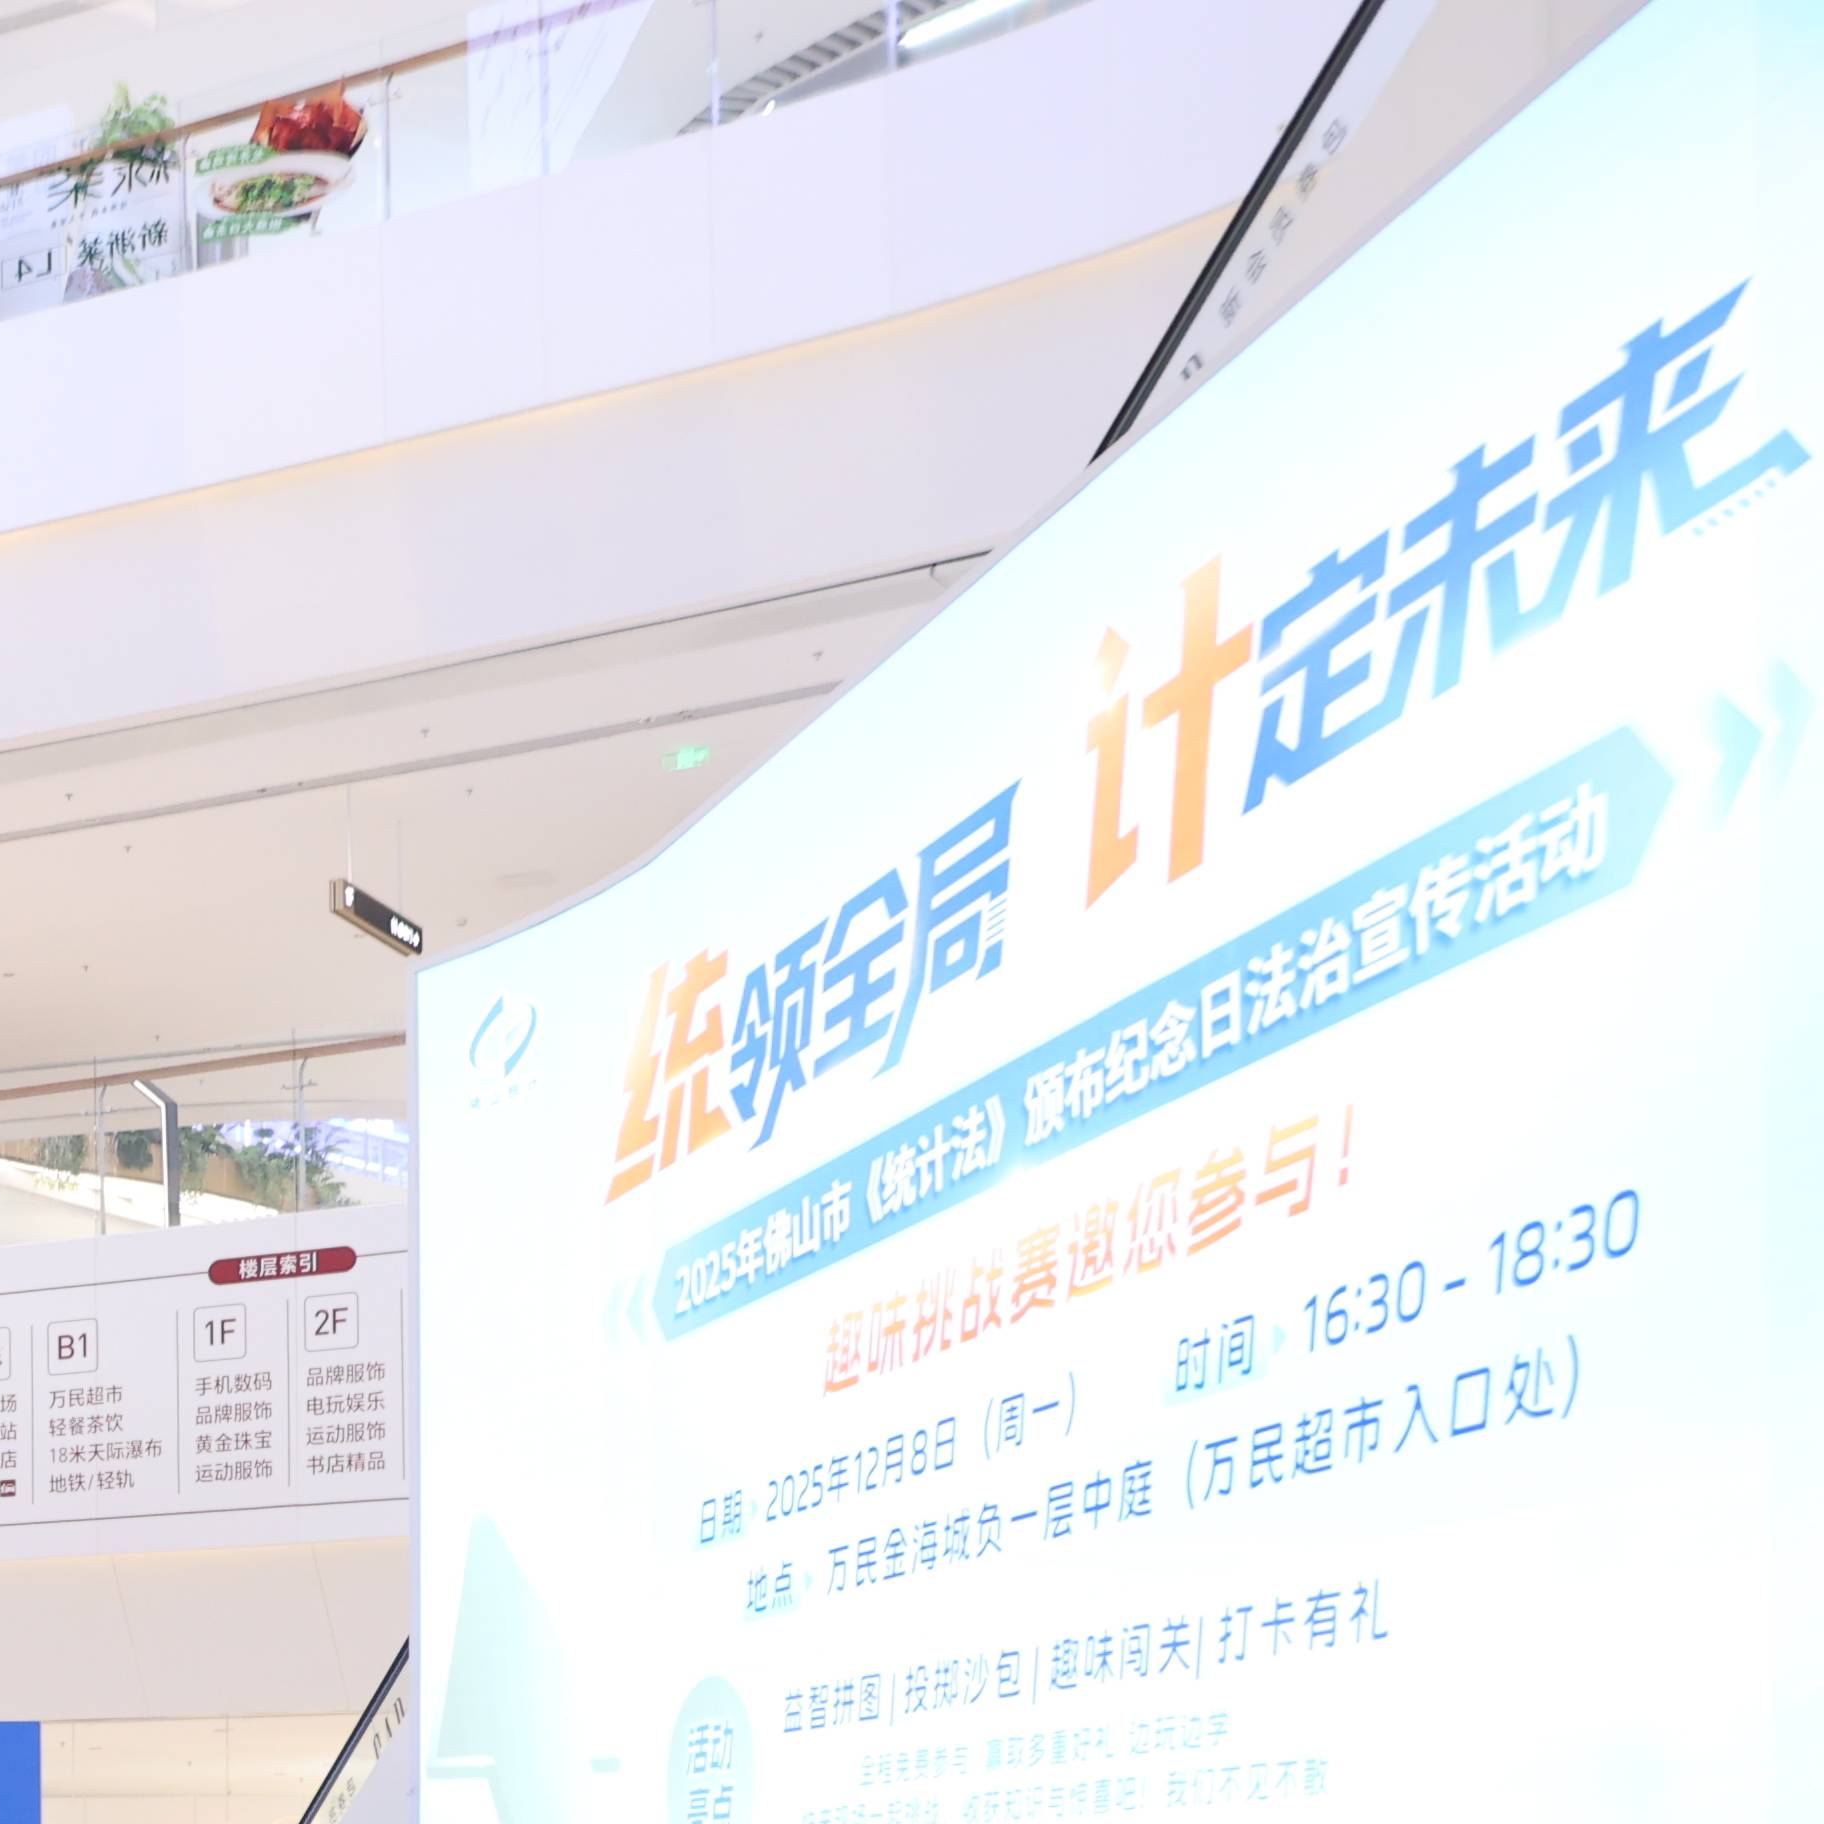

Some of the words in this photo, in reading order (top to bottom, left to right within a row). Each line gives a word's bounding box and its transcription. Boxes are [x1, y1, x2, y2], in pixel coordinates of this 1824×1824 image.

[605, 776, 1022, 1207] 统领全局
[1085, 275, 1813, 911] 计定未来
[673, 782, 1610, 1318] 2025年佛山市《统计法》颁布纪念日法治宣传活动
[238, 1251, 318, 1280] 楼层索引
[1173, 1315, 1255, 1395] 时间
[1304, 1258, 1427, 1356] 16:30
[1488, 1187, 1643, 1295] 18:30
[205, 1317, 238, 1346] 1F
[314, 1307, 349, 1336] 2F
[57, 1332, 90, 1361] B1
[195, 1371, 273, 1396] 手机数码
[306, 1361, 386, 1386] 品牌服饰
[49, 1385, 123, 1409] 万民超市
[306, 1390, 386, 1415] 电玩娱乐
[49, 1413, 123, 1437] 轻餐茶饮
[195, 1400, 273, 1425] 品牌服饰
[195, 1430, 273, 1454] 黄金珠宝
[306, 1421, 386, 1446] 运动服饰
[49, 1438, 163, 1464] 18米天际瀑布
[306, 1450, 386, 1475] 书店精品
[49, 1470, 135, 1494] 地铁/轻轨
[195, 1458, 273, 1483] 运动服饰
[699, 1489, 745, 1547] 日期
[746, 1558, 796, 1615] 地点
[783, 1673, 883, 1735] 益智拼图
[1217, 1578, 1390, 1667] 打卡有礼
